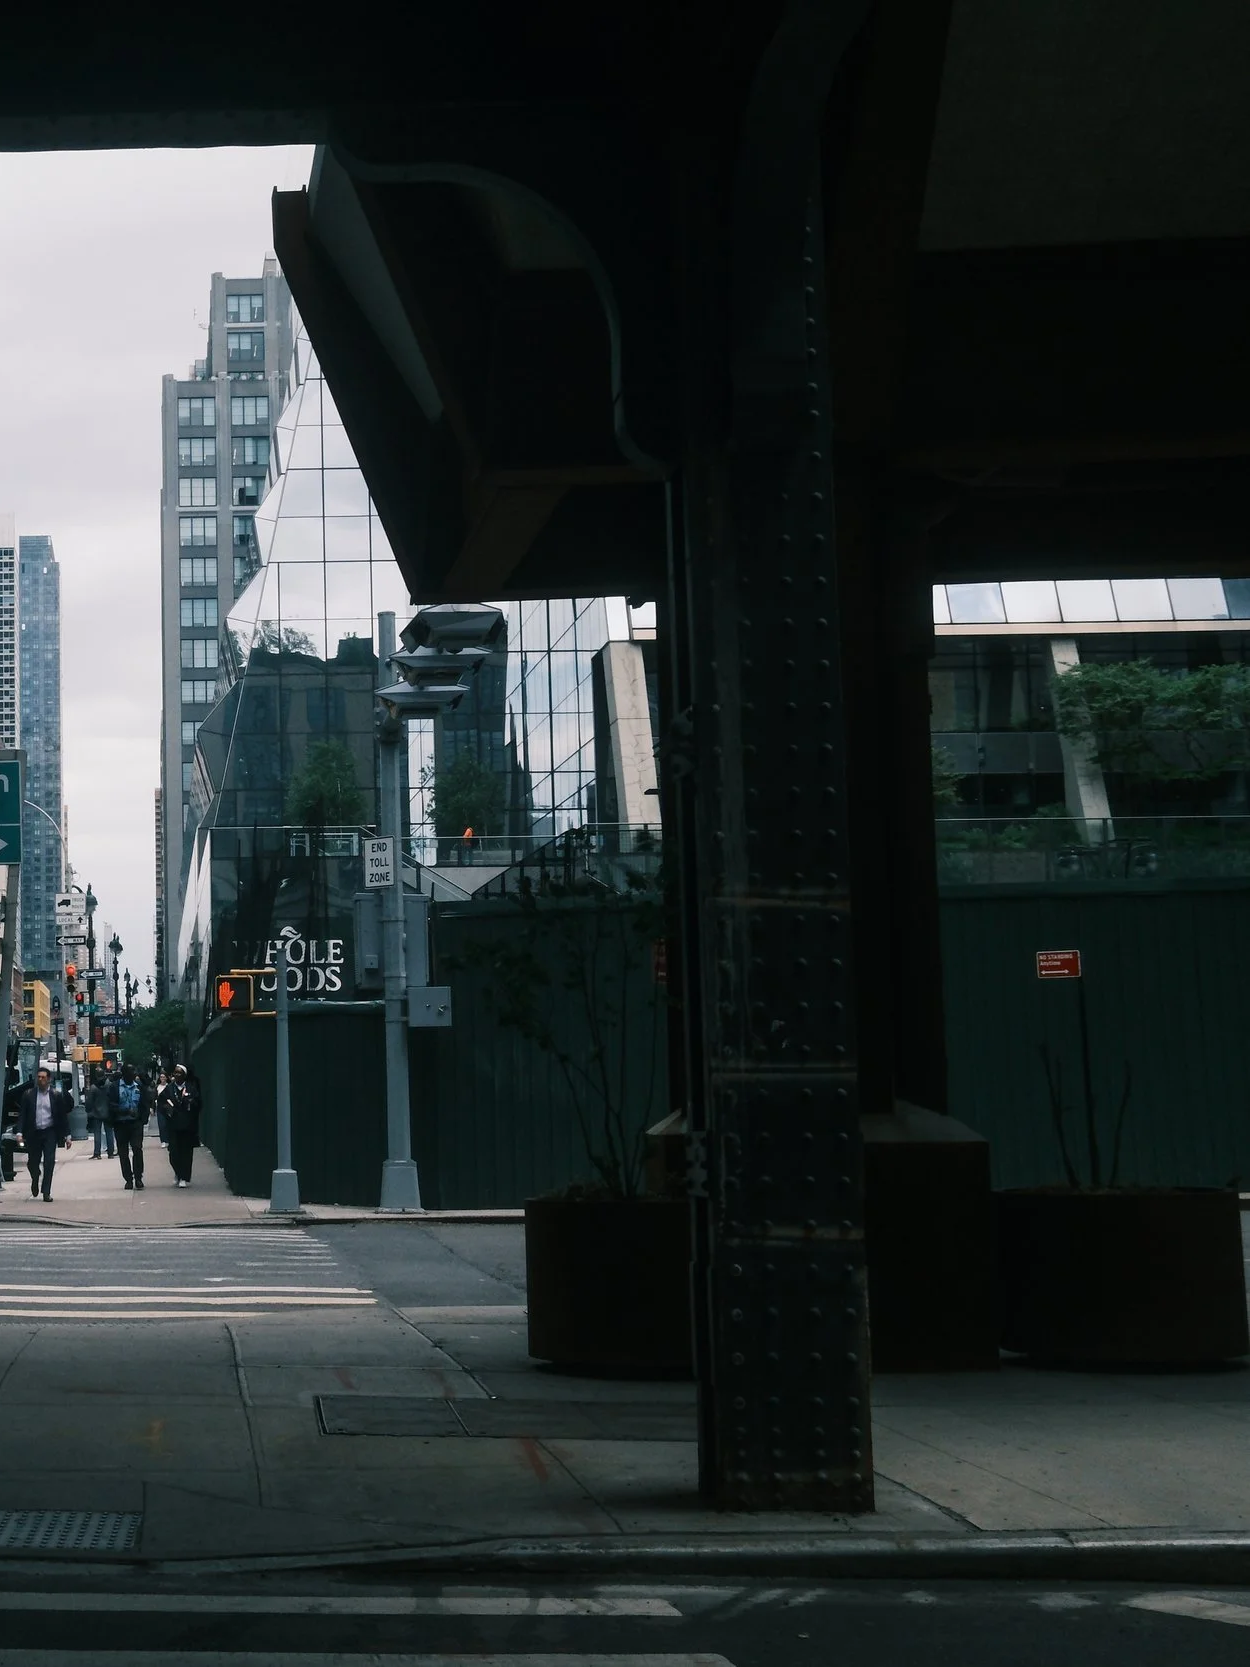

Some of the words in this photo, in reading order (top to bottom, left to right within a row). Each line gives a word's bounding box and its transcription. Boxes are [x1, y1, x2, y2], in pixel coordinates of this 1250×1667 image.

[371, 842, 387, 853] END
[370, 857, 389, 868] TOLL
[369, 872, 390, 883] ZONE
